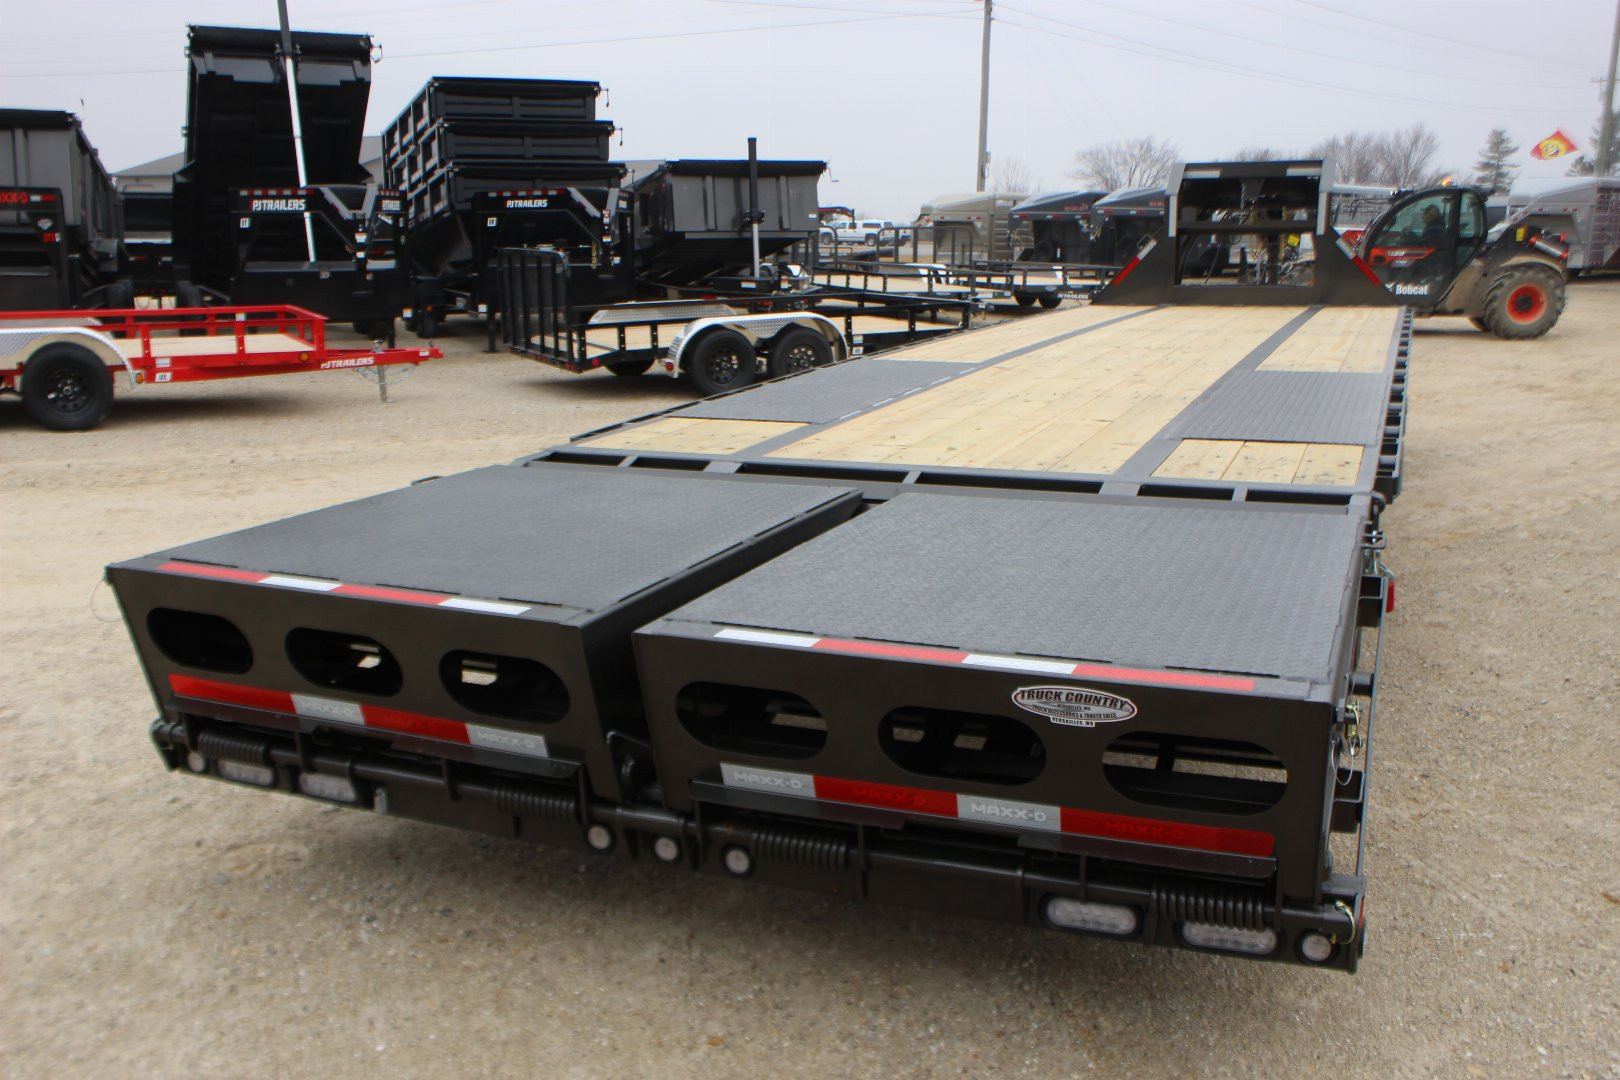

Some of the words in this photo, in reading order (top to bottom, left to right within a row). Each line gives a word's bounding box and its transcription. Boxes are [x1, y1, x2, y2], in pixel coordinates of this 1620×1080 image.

[1395, 284, 1428, 296] Bobcat
[1020, 690, 1062, 701] TRUCK
[1065, 692, 1126, 709] COUNTRY
[1032, 704, 1048, 713] TRUCK
[1048, 708, 1079, 718] ACCESSORIES
[732, 771, 803, 789] MAXX-D
[970, 802, 1048, 822] MAXX-D
